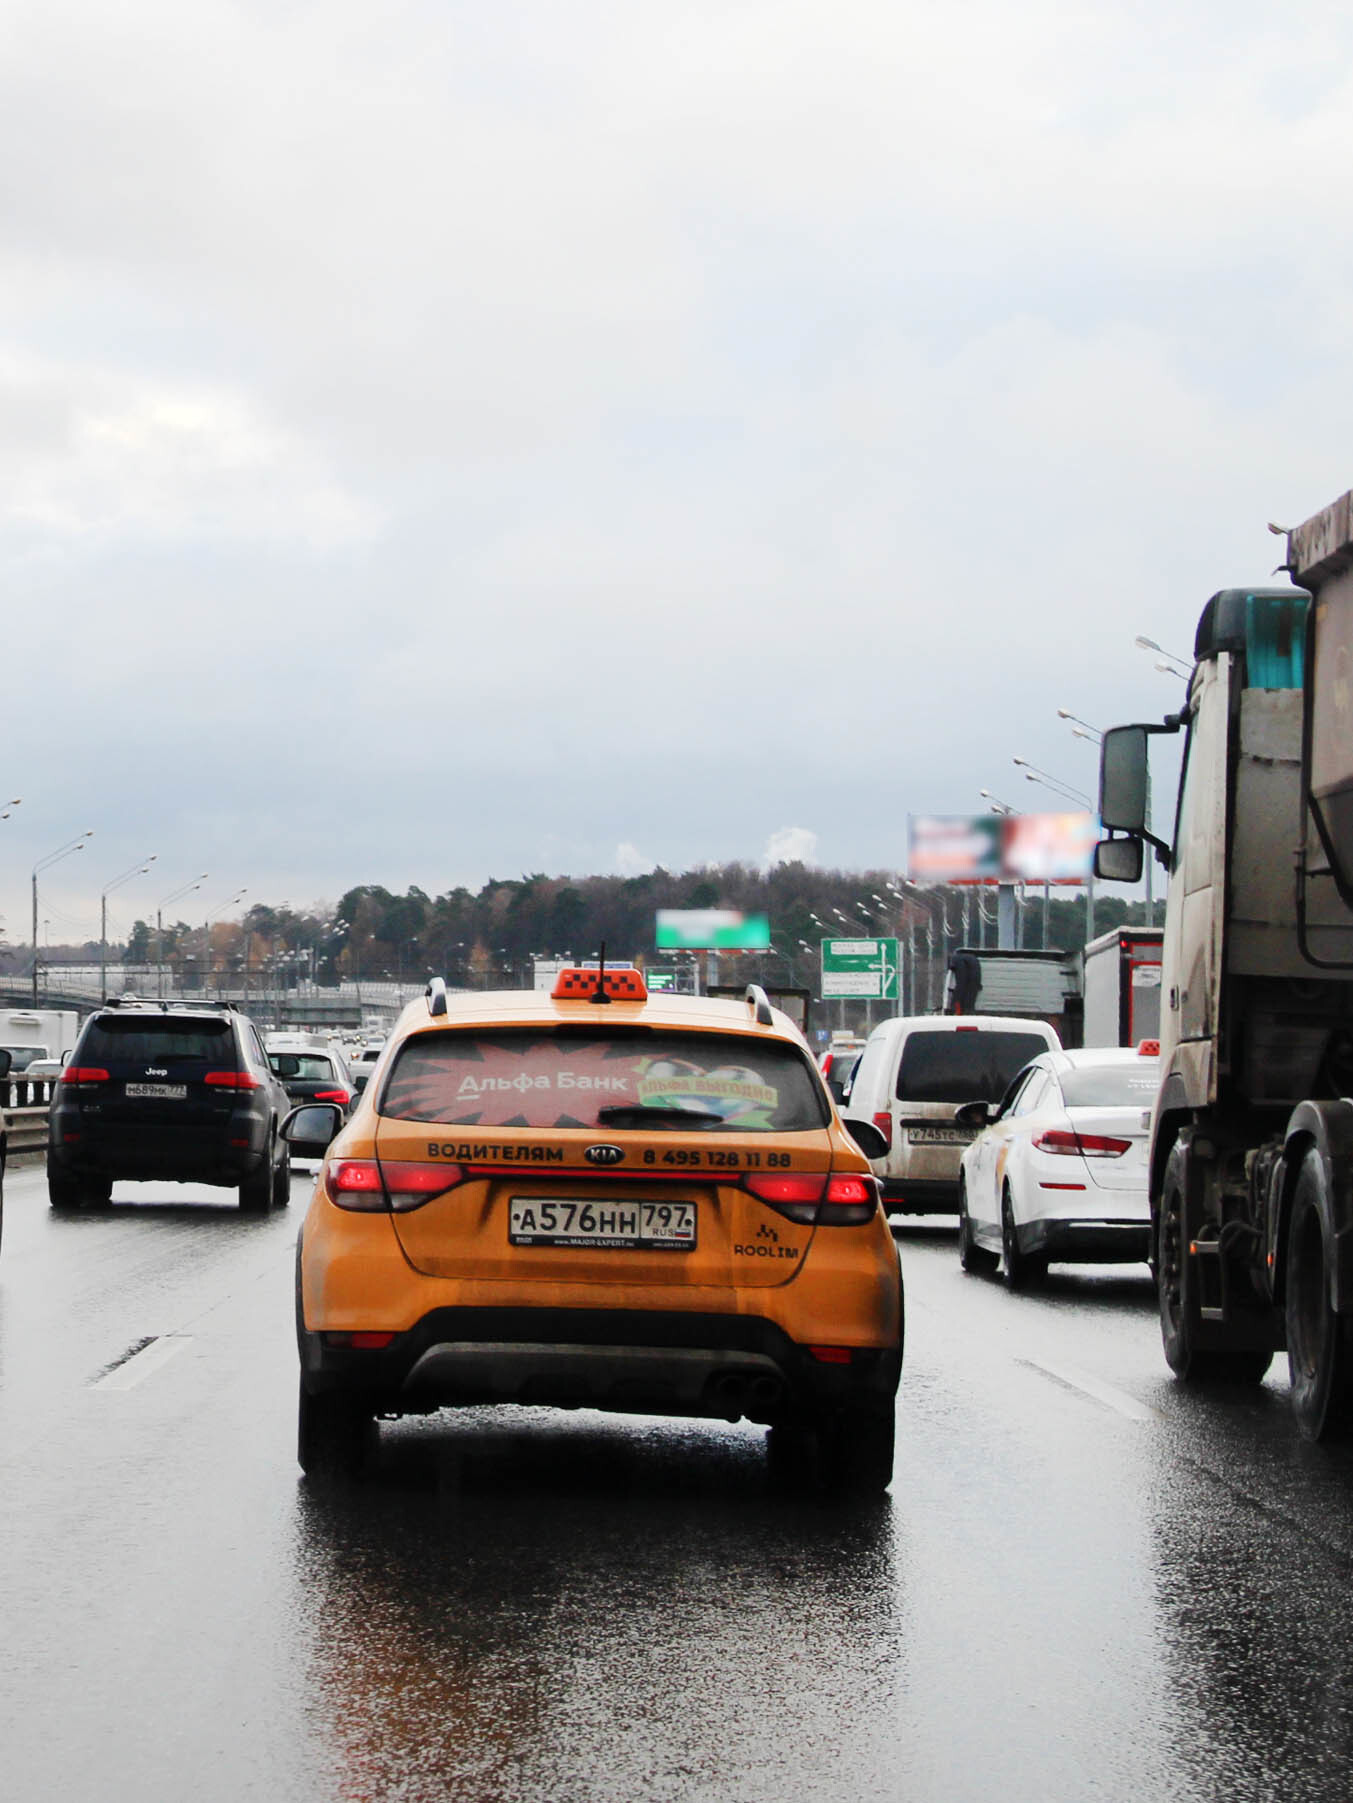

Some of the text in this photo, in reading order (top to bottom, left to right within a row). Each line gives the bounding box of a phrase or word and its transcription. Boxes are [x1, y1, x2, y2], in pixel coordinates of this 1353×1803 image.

[145, 1067, 168, 1076] Jeep
[456, 1072, 629, 1099] Альфа Банк
[427, 1143, 564, 1161] ВОДИТЕЛЯМ
[590, 1149, 618, 1161] KIA
[644, 1150, 791, 1167] 8 495 128 11 88
[520, 1203, 687, 1234] А576НН 797
[653, 1227, 674, 1237] RUS
[735, 1244, 799, 1258] ROOLIM
